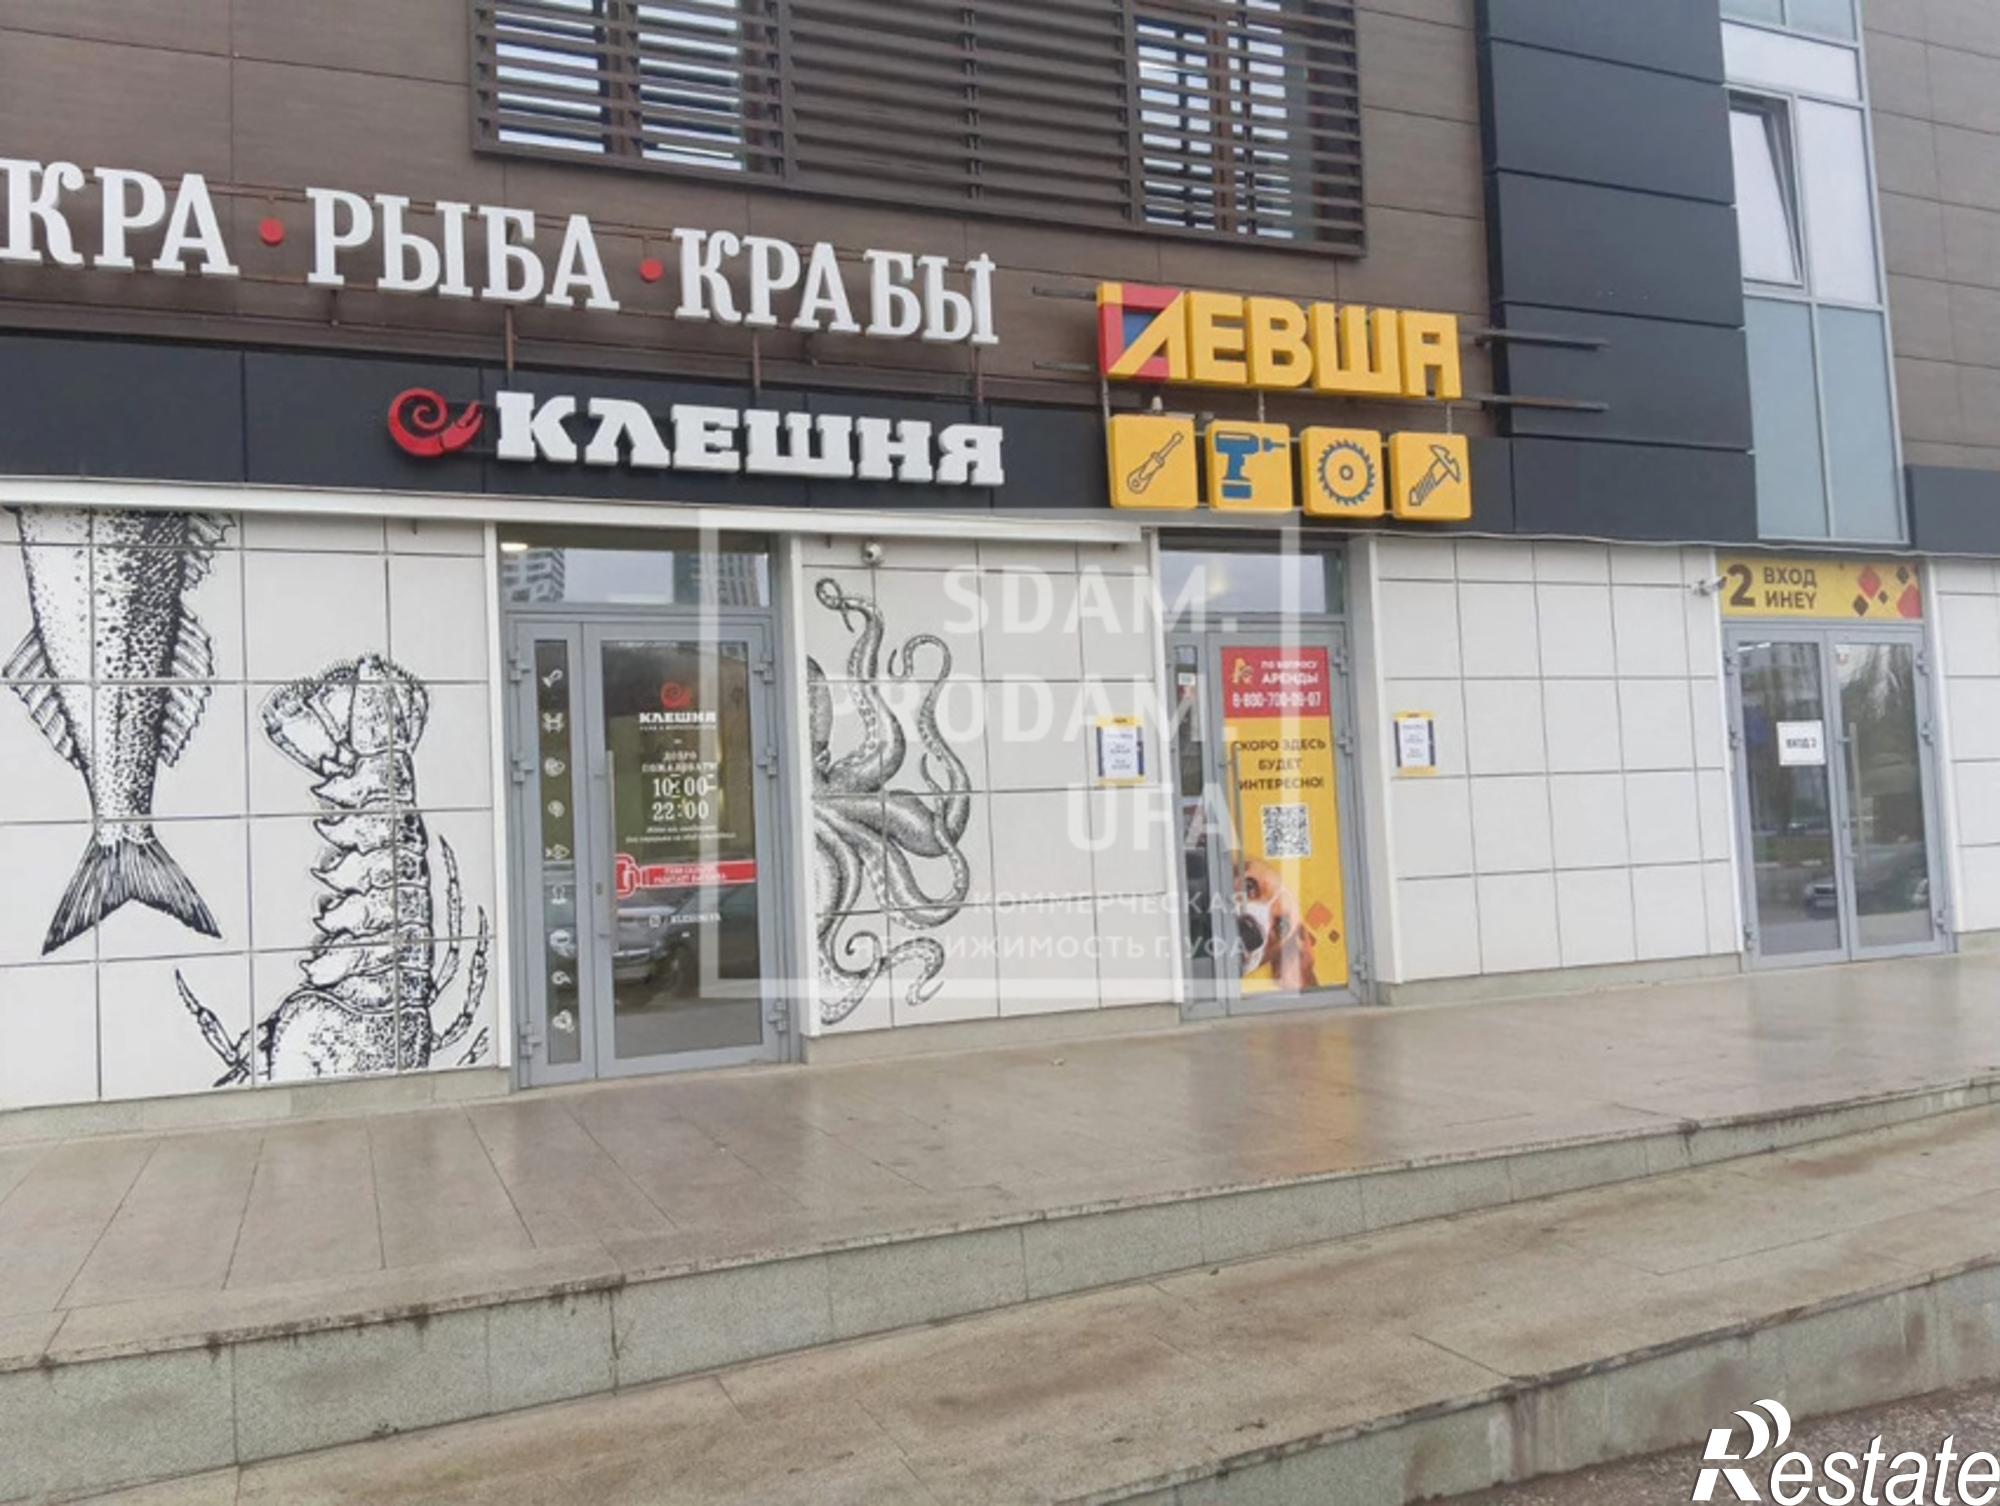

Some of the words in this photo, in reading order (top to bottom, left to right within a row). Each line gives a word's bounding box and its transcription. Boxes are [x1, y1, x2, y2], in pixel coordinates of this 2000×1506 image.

[305, 186, 620, 311] РЫБА
[672, 227, 999, 345] КРАБЫ
[1097, 281, 1463, 400] ЛЕВША
[496, 390, 1004, 486] КЛЕШНЯ
[1727, 563, 1755, 607] 2
[1763, 566, 1818, 589] ВХОД
[1262, 672, 1319, 685] АРЕНДЫ
[639, 711, 717, 724] КЛЕШНЯ
[1283, 738, 1326, 751] ЗДЕСЬ
[1258, 758, 1303, 772] БУДЕТ
[1239, 776, 1324, 791] ИНТЕРЕСНО!
[652, 801, 709, 821] 22:00
